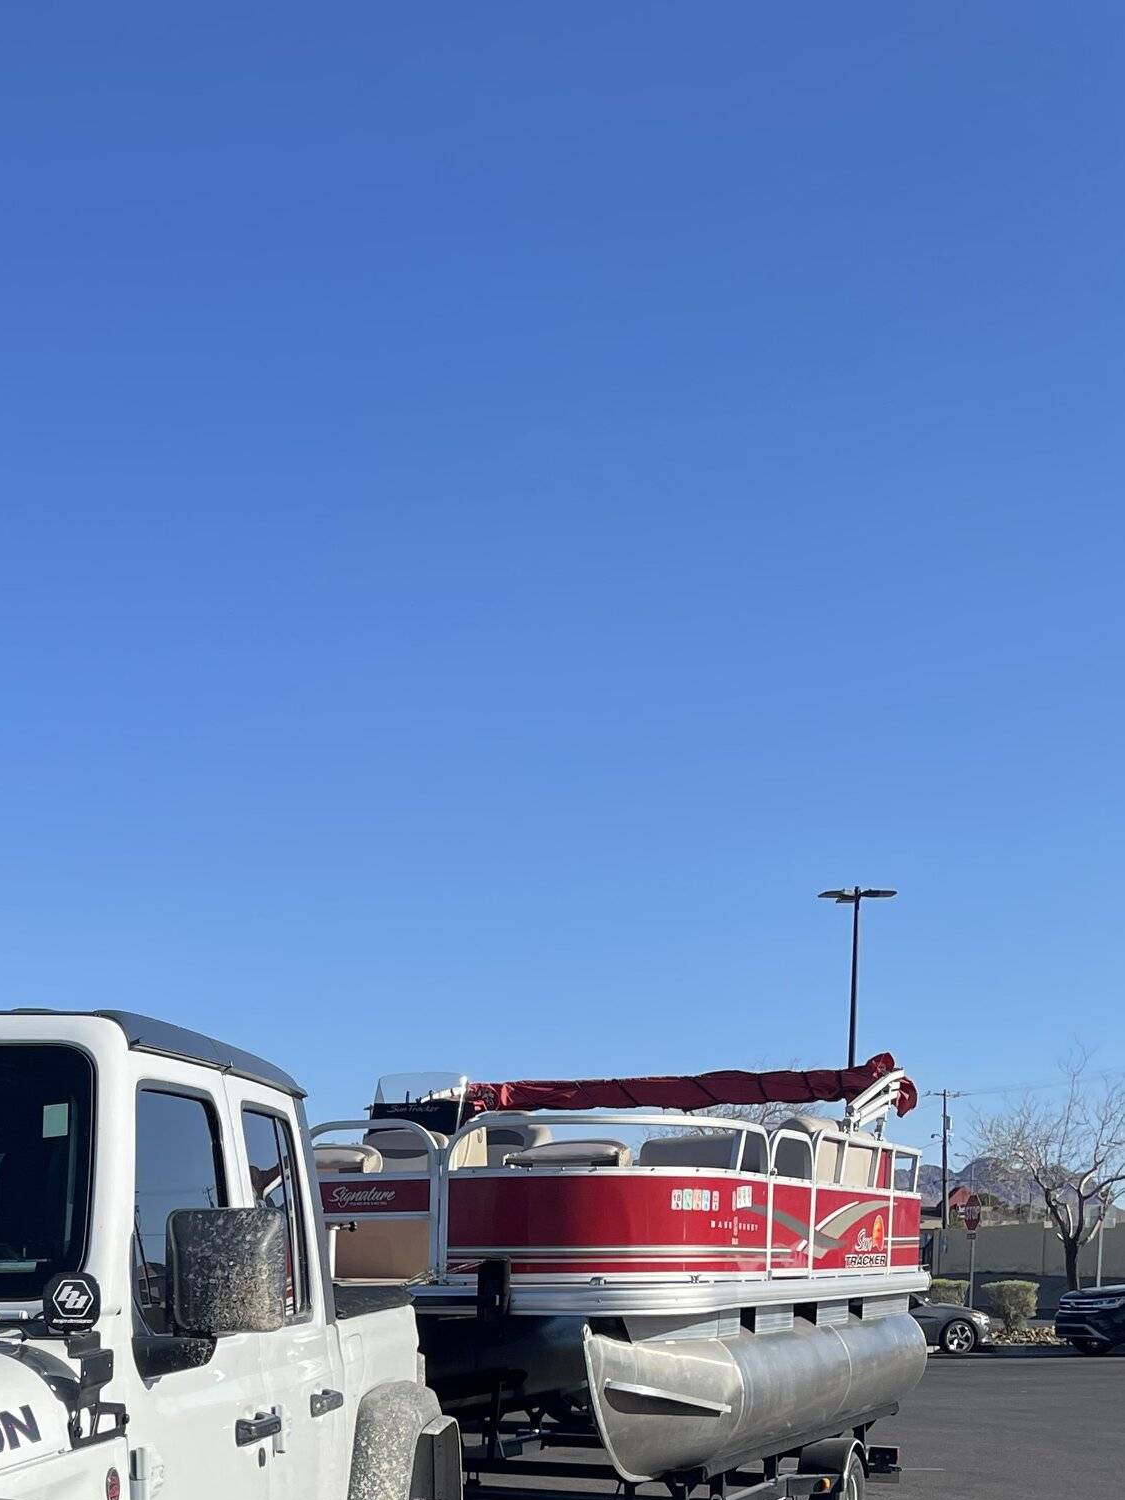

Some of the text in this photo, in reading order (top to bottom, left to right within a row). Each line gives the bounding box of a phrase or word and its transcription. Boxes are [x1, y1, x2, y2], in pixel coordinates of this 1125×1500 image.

[328, 1186, 396, 1208] Signature
[855, 1228, 875, 1251] Sun
[845, 1253, 887, 1268] TRACKER
